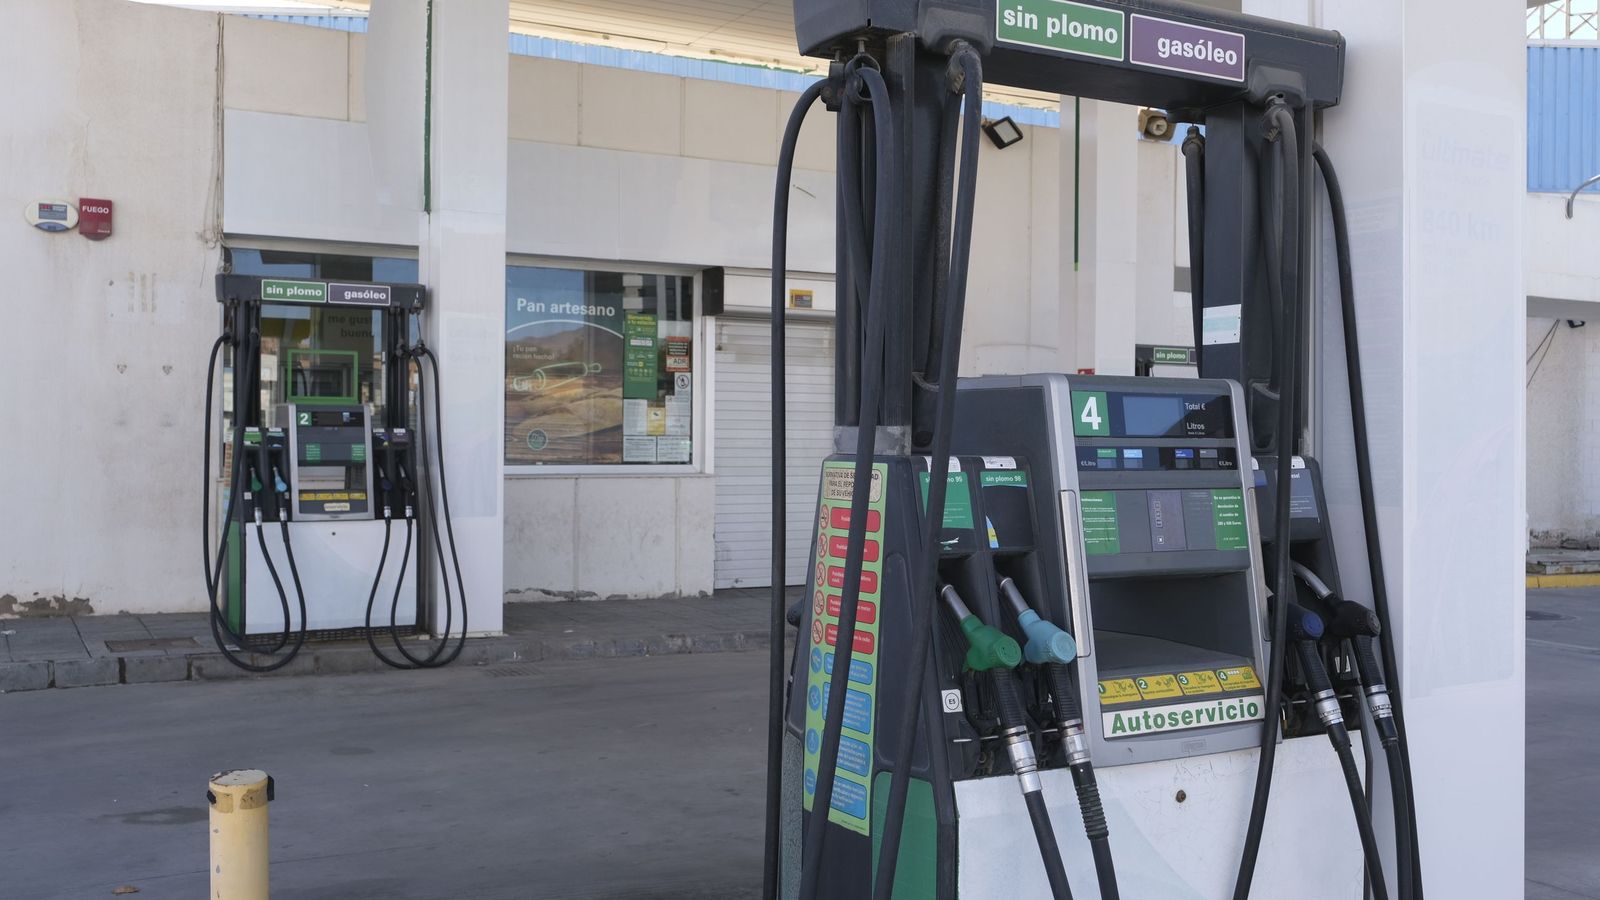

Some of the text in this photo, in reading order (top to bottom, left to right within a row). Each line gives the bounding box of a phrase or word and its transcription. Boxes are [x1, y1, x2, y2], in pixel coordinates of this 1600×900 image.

[1004, 6, 1118, 44] sin plomo
[1157, 37, 1237, 65] gasóleo
[82, 205, 109, 214] FUEGO
[266, 286, 322, 297] sin plomo
[344, 290, 386, 300] gasóleo
[517, 298, 615, 317] Pan artesano
[1166, 352, 1186, 360] plomo
[1080, 396, 1102, 430] 4
[300, 413, 309, 425] 2
[995, 475, 1013, 483] plomo
[1098, 684, 1104, 693] 1
[1112, 699, 1258, 734] Autoservicio
